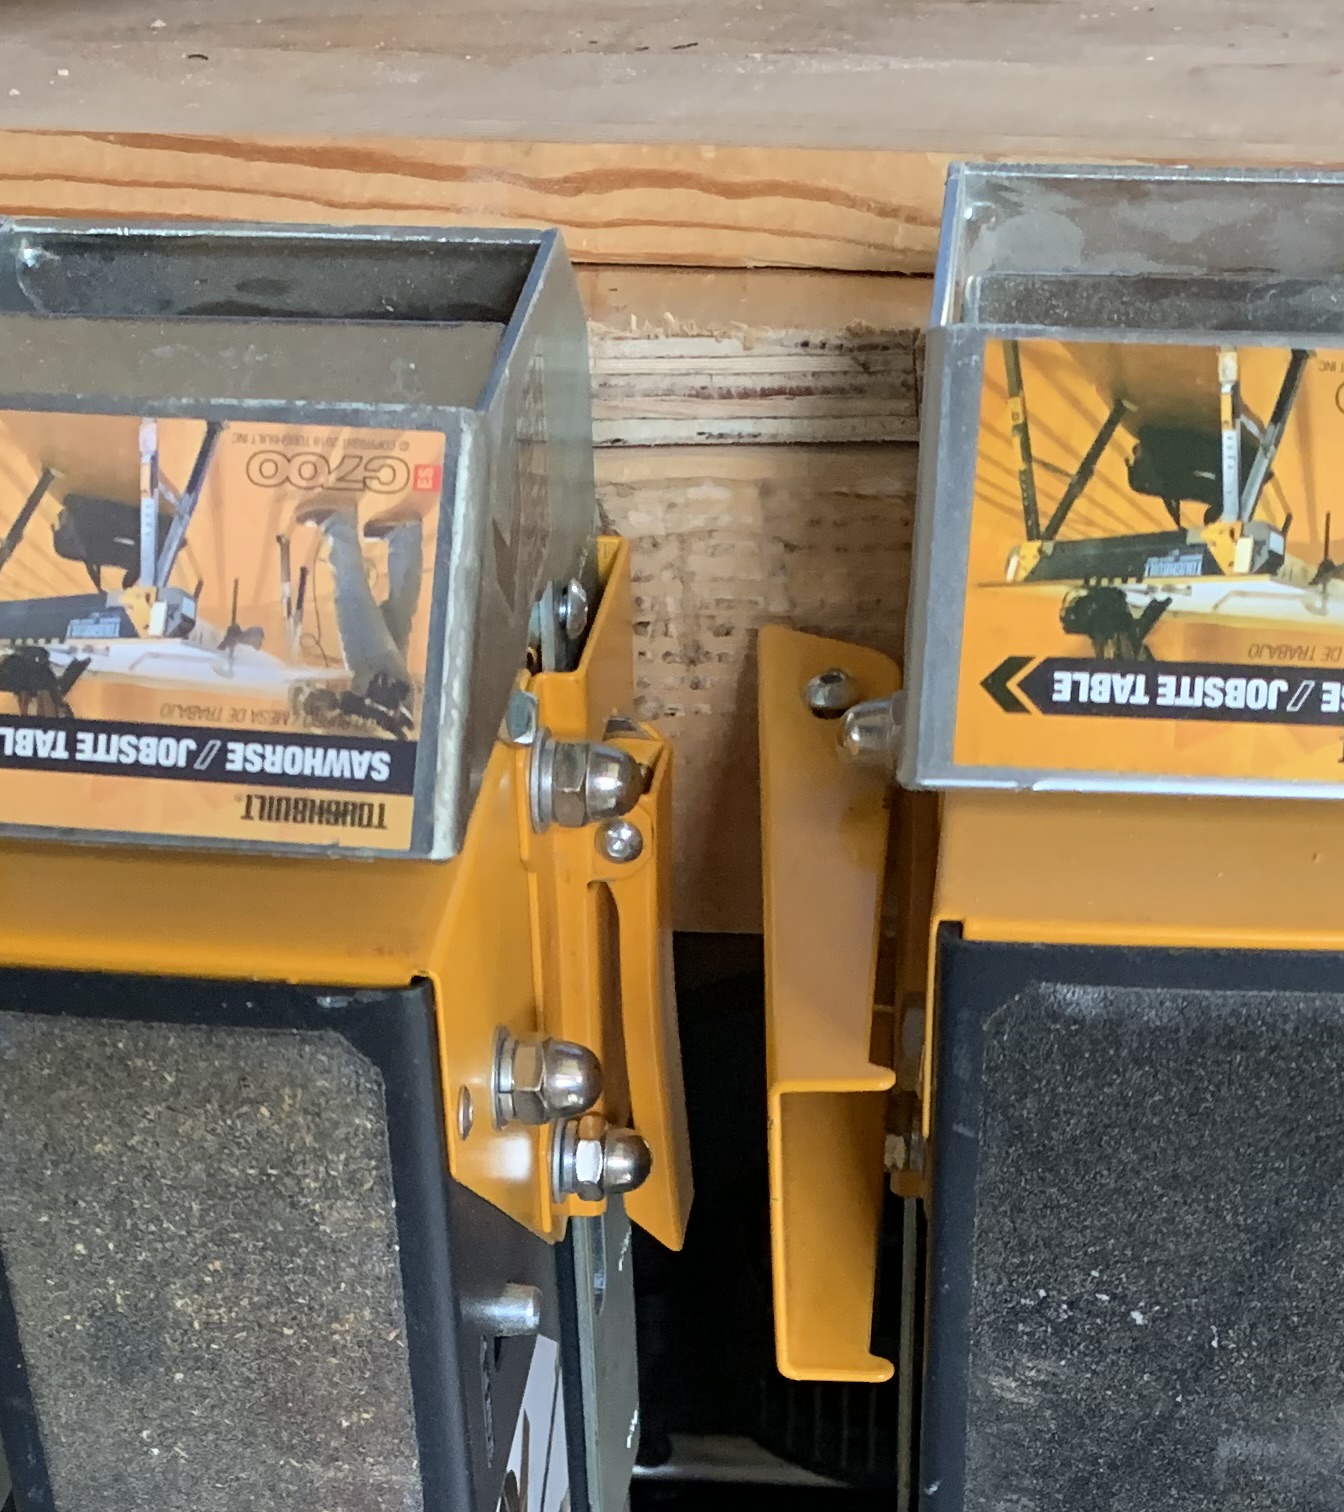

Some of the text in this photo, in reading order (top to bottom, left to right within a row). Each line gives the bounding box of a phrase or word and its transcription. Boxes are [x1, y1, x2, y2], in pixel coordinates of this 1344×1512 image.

[246, 450, 410, 495] C700
[1248, 643, 1318, 661] TRABAJO
[1324, 646, 1342, 663] DE
[1052, 670, 1150, 705] TABLE
[1156, 675, 1288, 711] JOBSITE
[76, 732, 197, 767] JOBSITE
[225, 742, 391, 781] SAWHORSE
[240, 794, 388, 830] TOUGHBUILT
